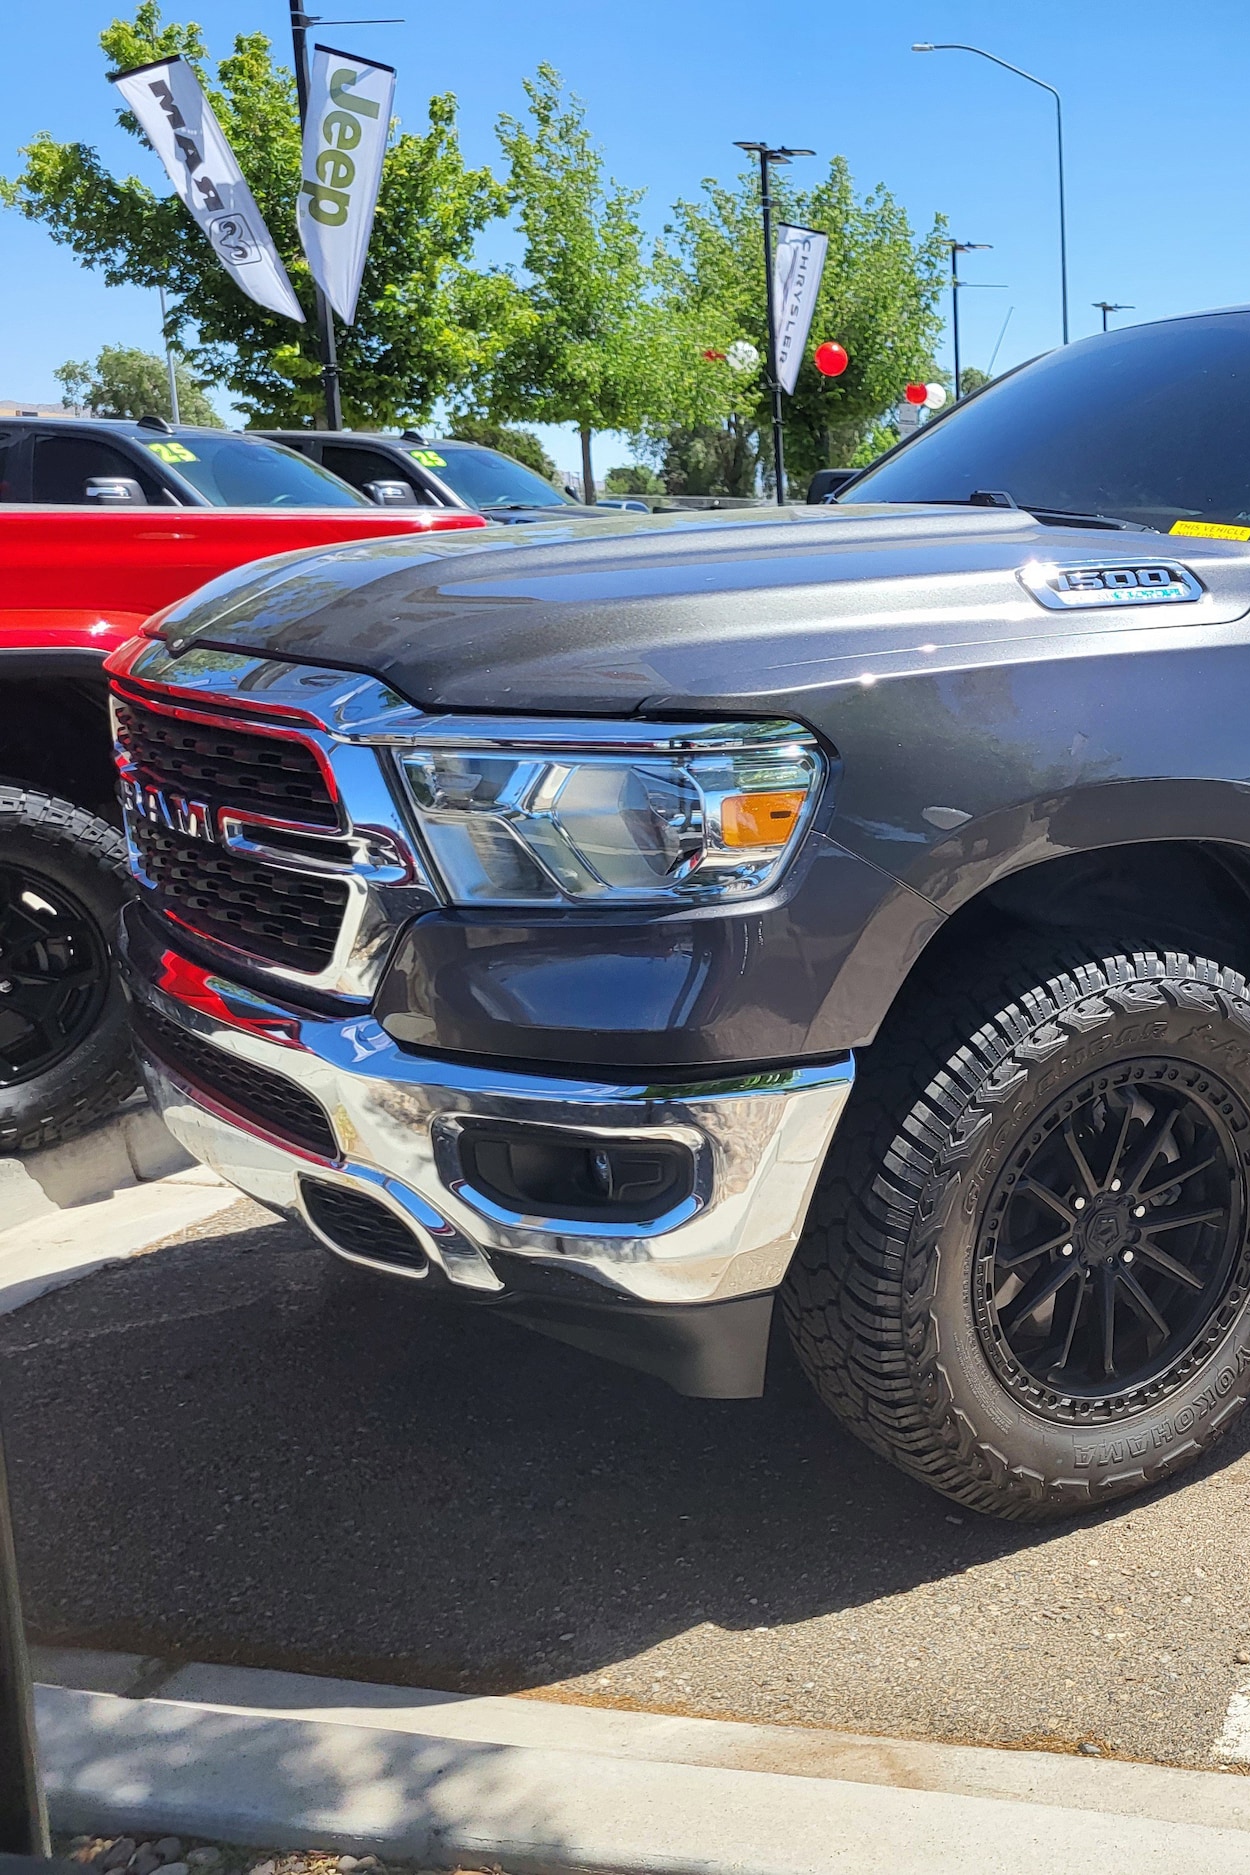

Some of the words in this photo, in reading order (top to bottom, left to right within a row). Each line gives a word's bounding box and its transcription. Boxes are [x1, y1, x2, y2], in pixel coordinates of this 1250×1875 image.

[301, 68, 381, 227] Jeep
[779, 238, 812, 364] CHRYSLER
[148, 442, 197, 464] 25
[410, 450, 448, 468] 25
[1179, 523, 1200, 531] THIS
[1204, 525, 1248, 537] VEHICLE
[1057, 568, 1171, 592] 1500
